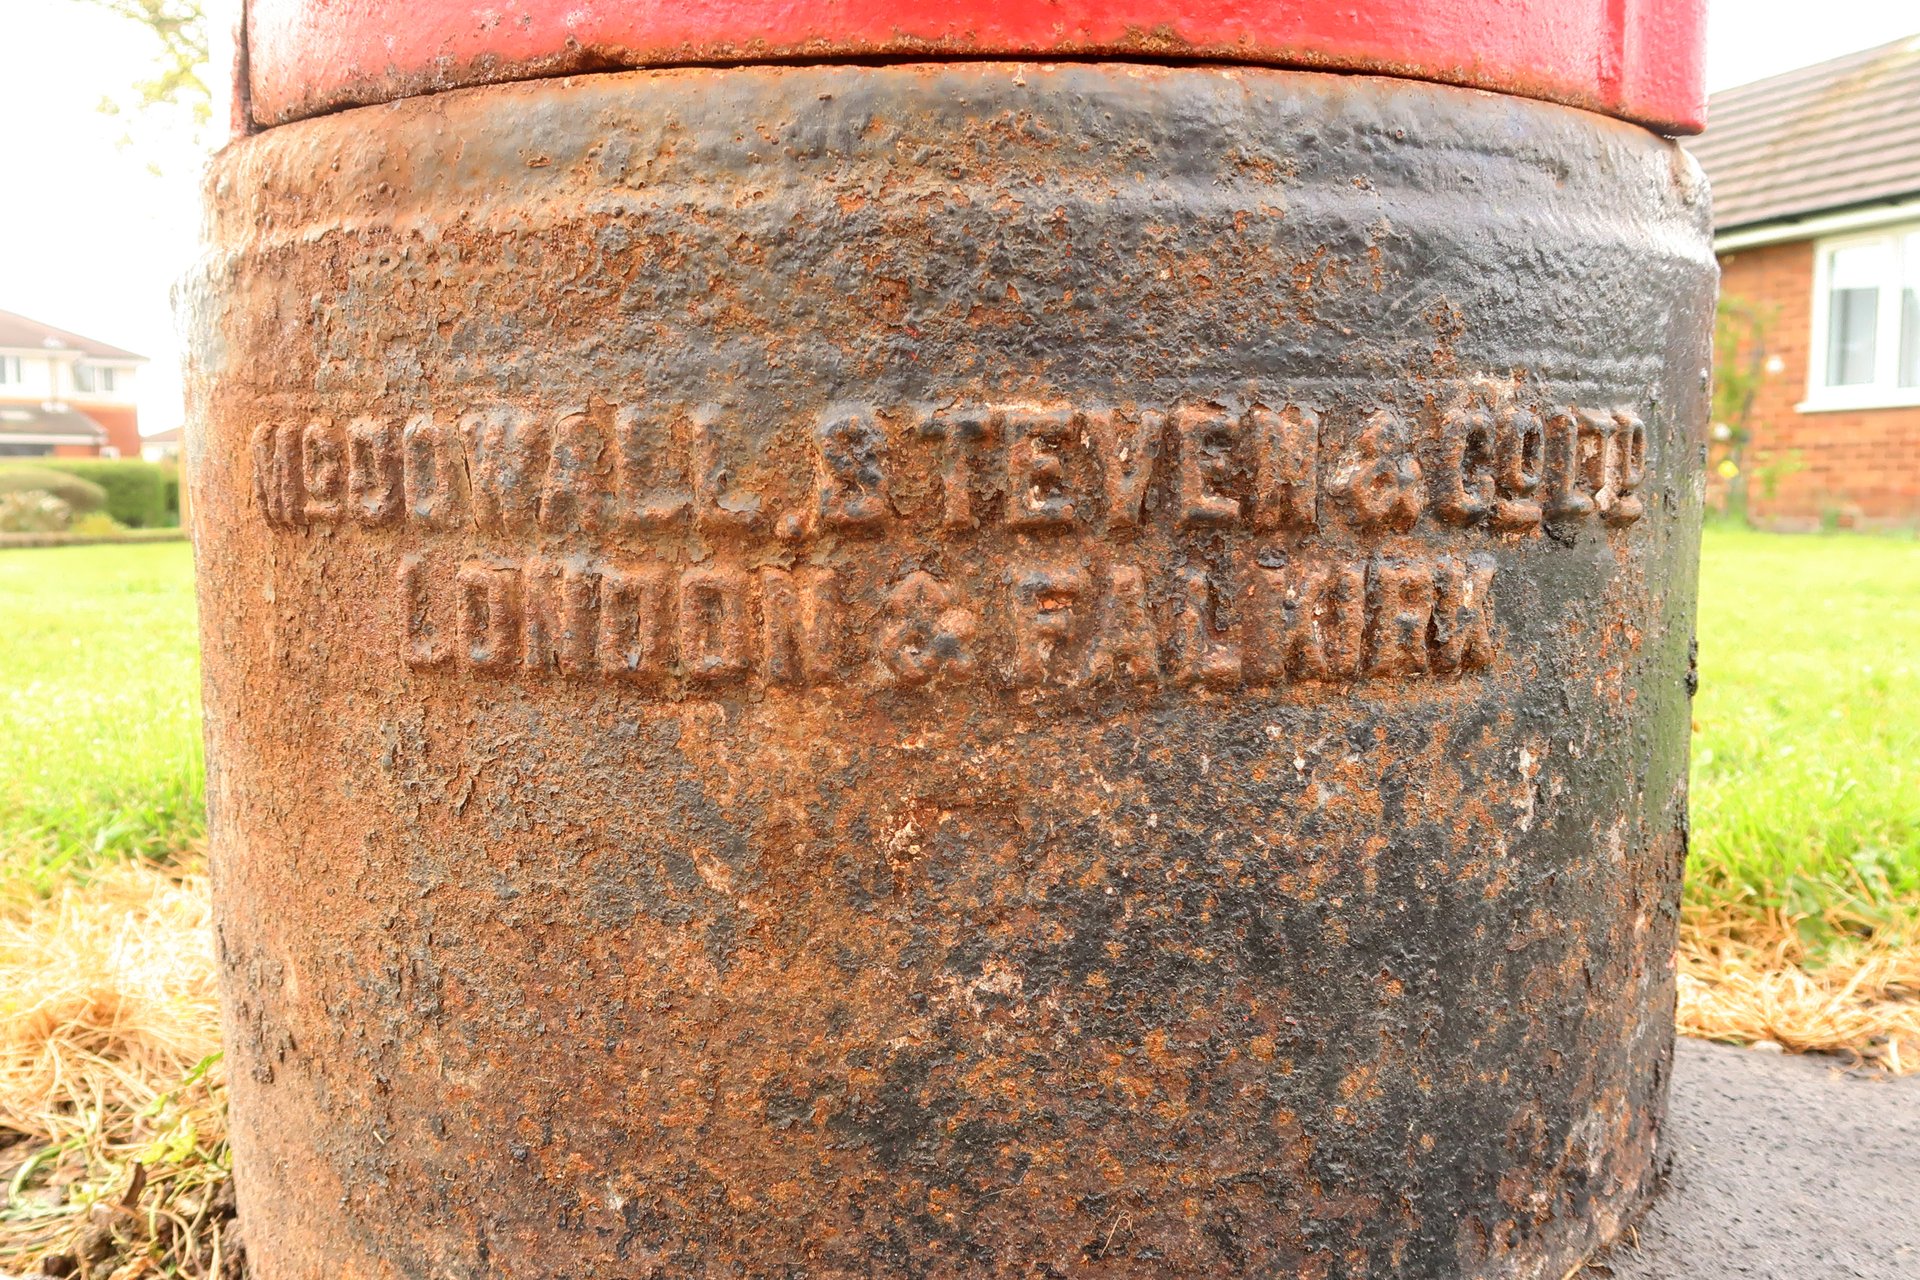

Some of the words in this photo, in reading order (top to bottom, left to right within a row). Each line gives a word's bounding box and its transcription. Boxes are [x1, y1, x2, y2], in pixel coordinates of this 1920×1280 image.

[815, 401, 1319, 536] STEVEN
[1328, 408, 1422, 532] &
[399, 552, 840, 686] LONDON
[880, 568, 976, 688] &
[1012, 552, 1497, 690] FALKIRK
